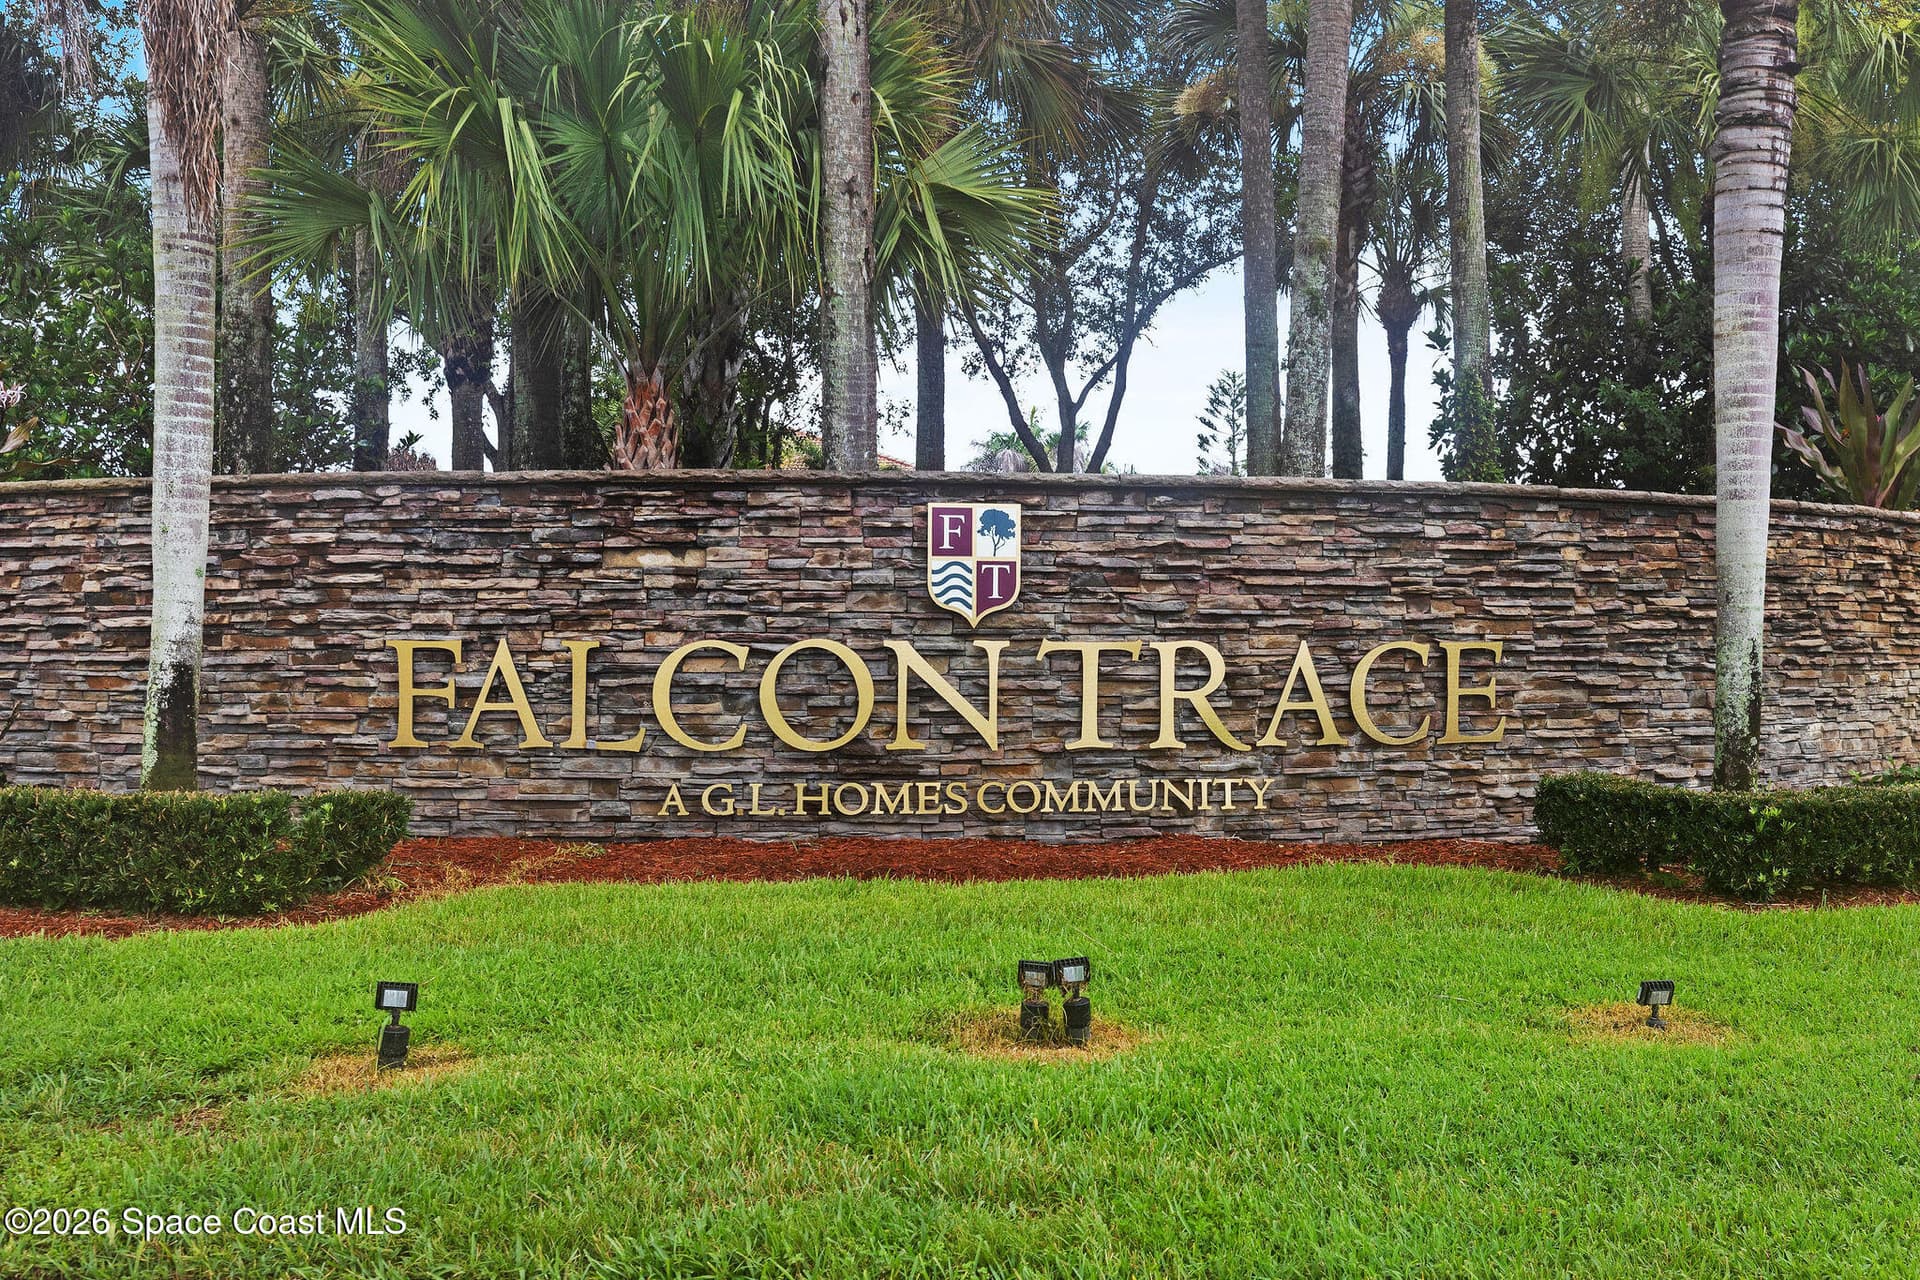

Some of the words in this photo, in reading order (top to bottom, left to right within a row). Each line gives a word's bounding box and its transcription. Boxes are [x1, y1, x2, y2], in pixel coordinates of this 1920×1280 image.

[938, 514, 966, 550] F
[981, 564, 1011, 599] T
[385, 638, 1011, 753] FALCON
[1035, 639, 1506, 753] TRACE
[657, 783, 690, 816] A
[793, 782, 968, 816] HOMES
[976, 778, 1275, 814] COMMUNITY
